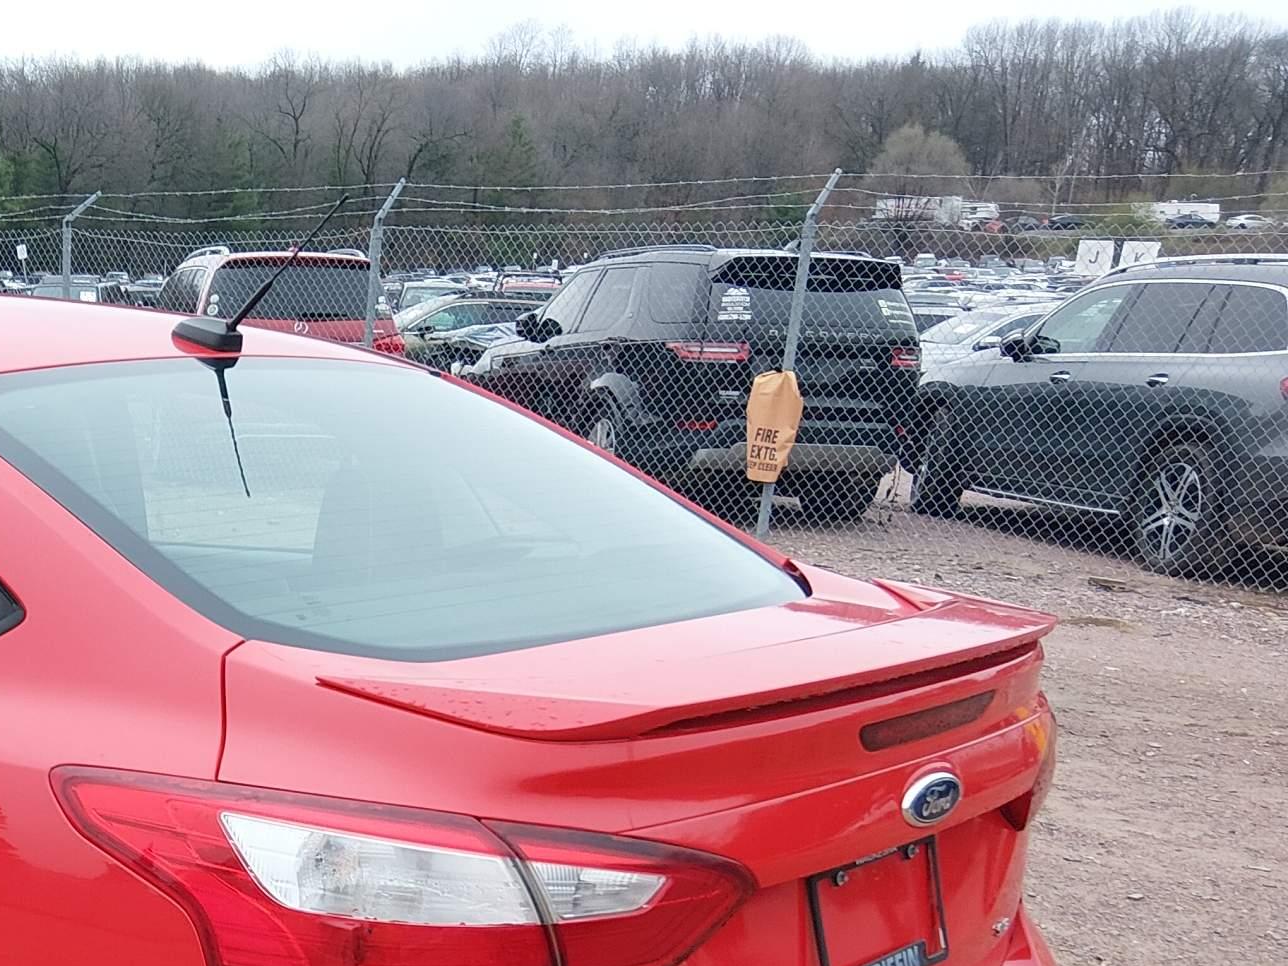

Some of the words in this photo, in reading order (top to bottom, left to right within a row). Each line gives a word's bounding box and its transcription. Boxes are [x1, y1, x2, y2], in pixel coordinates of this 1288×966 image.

[1088, 250, 1100, 264] J
[1134, 251, 1145, 263] K
[755, 428, 779, 443] FIRE
[750, 445, 777, 461] EXTG.
[922, 783, 954, 818] Ford
